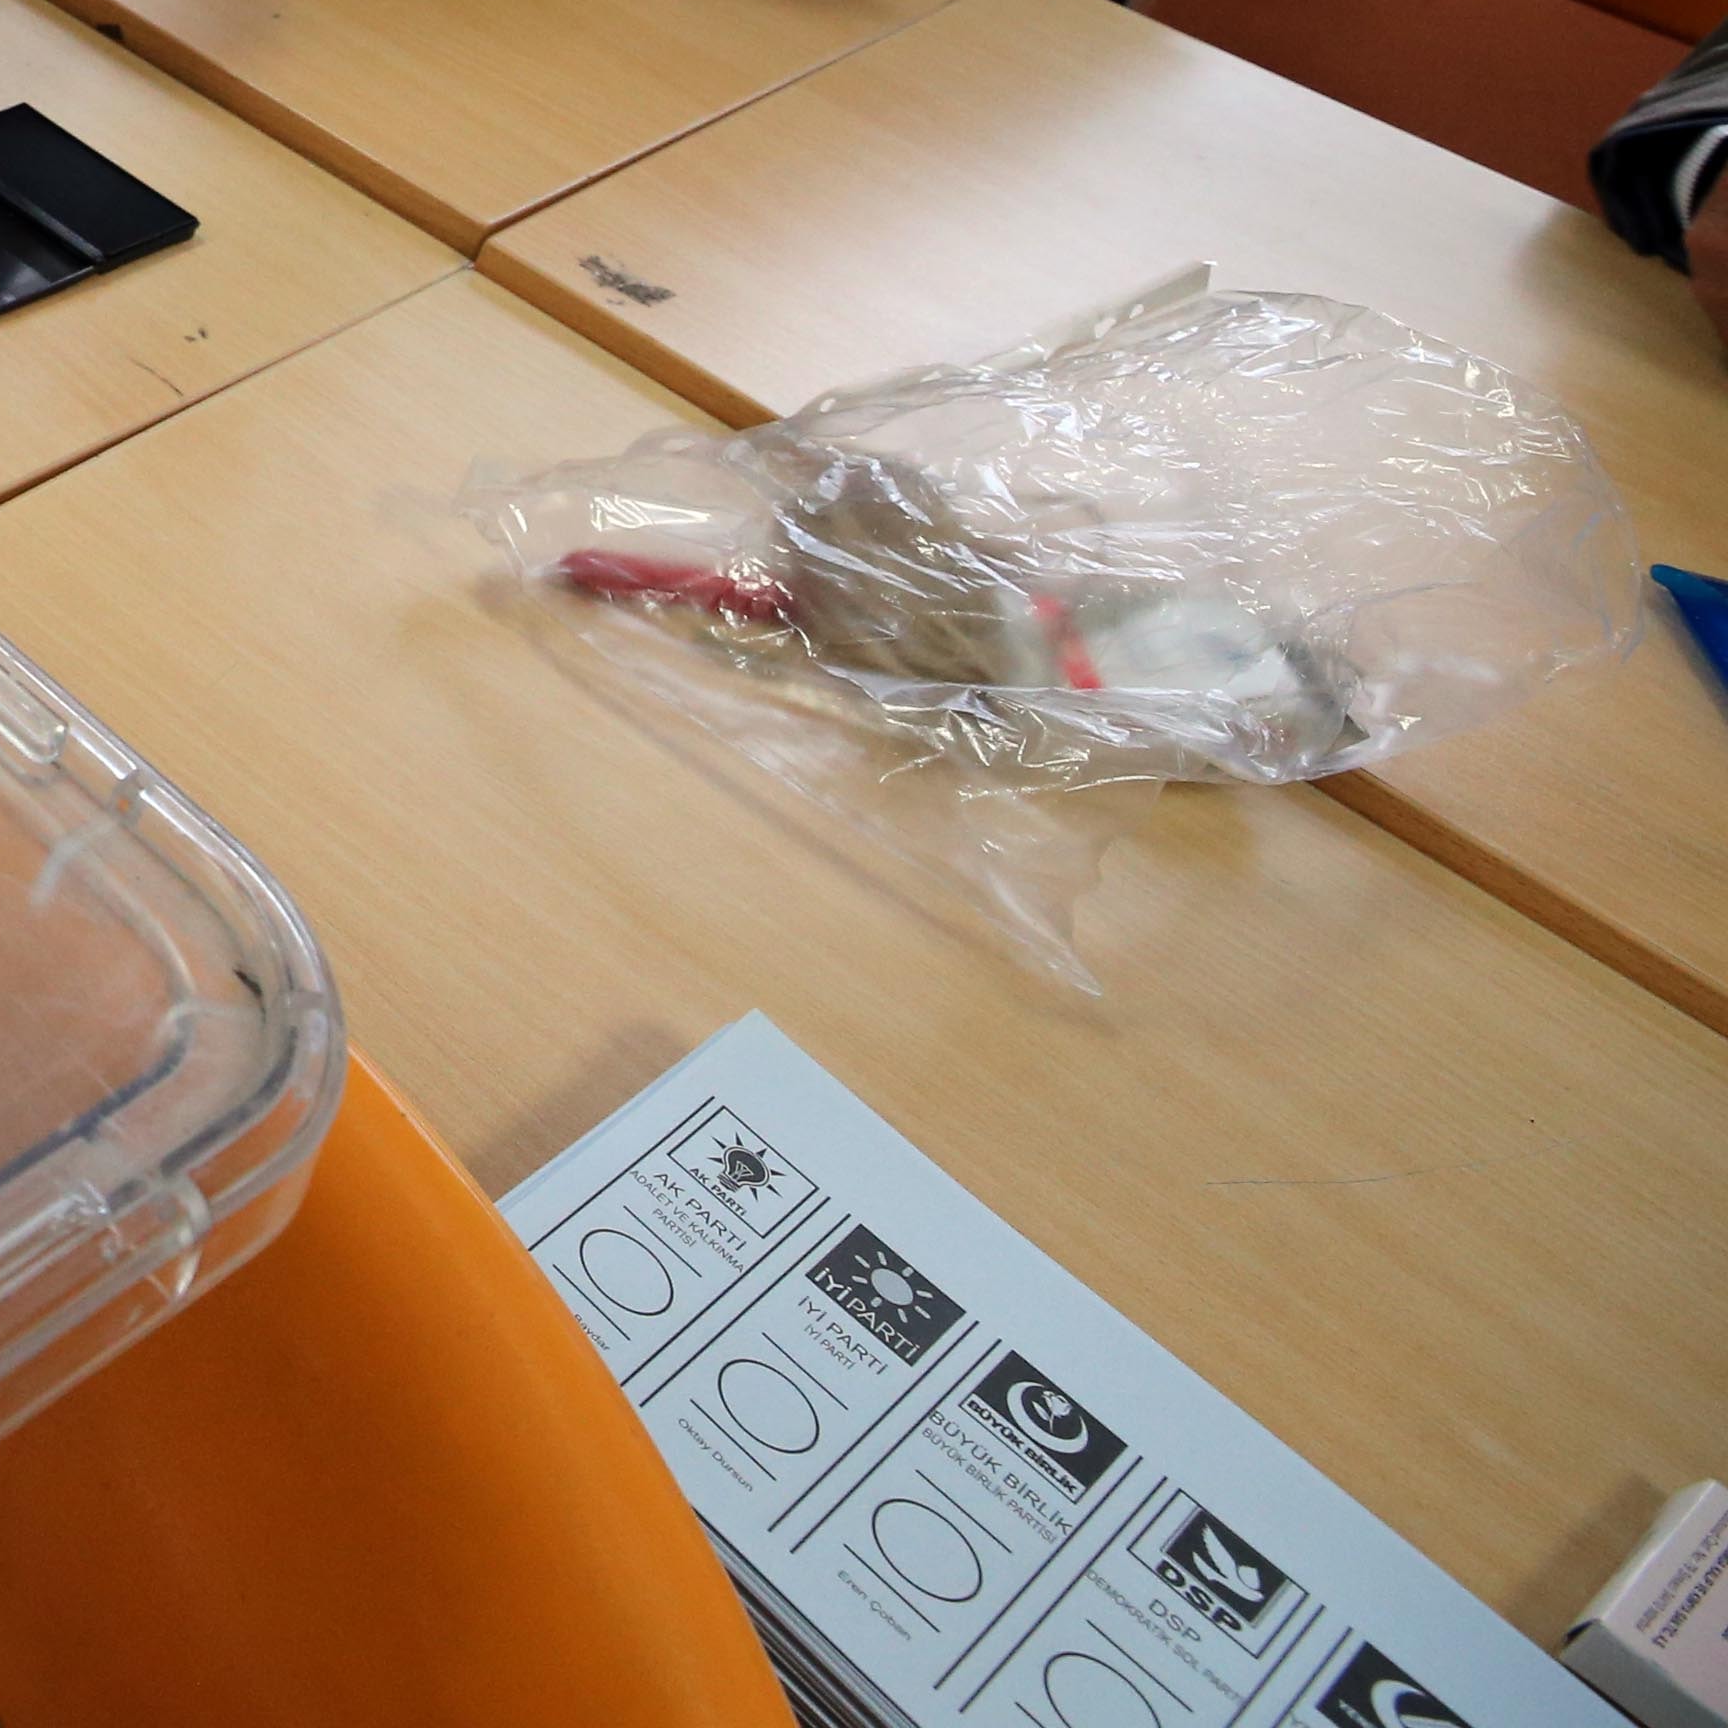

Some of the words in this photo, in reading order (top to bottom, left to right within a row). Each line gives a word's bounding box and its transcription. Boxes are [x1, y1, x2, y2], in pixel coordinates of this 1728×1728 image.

[629, 1170, 674, 1207] ADALET
[673, 1206, 690, 1224] VE
[688, 1221, 744, 1274] KALKINMA
[652, 1208, 697, 1248] PARTİSİ
[653, 1173, 686, 1199] AK
[684, 1198, 747, 1252] PARTİ
[687, 1168, 710, 1185] AK
[710, 1184, 747, 1217] PARTİ
[797, 1295, 828, 1323] İYİ
[825, 1322, 889, 1376] PARTİ
[803, 1323, 823, 1341] İYİ
[819, 1338, 857, 1371] PARTİ
[814, 1267, 853, 1302] İYİ
[846, 1297, 921, 1359] PARTİ
[678, 1418, 712, 1451] Oktay
[711, 1450, 753, 1493] Dursun
[928, 1410, 1003, 1475] BÜYÜK
[1002, 1472, 1073, 1537] BİRLİK
[966, 1399, 1025, 1450] BÜYÜK
[1023, 1447, 1078, 1495] BİRLİK
[921, 1427, 968, 1468] BÜYÜK
[964, 1463, 1009, 1502] BİRLİK
[1005, 1499, 1058, 1545] PARTİSİ
[837, 1570, 868, 1601] Eren
[869, 1600, 912, 1642] Çoban
[1148, 1598, 1202, 1643] DSP
[1156, 1560, 1242, 1632] DSP
